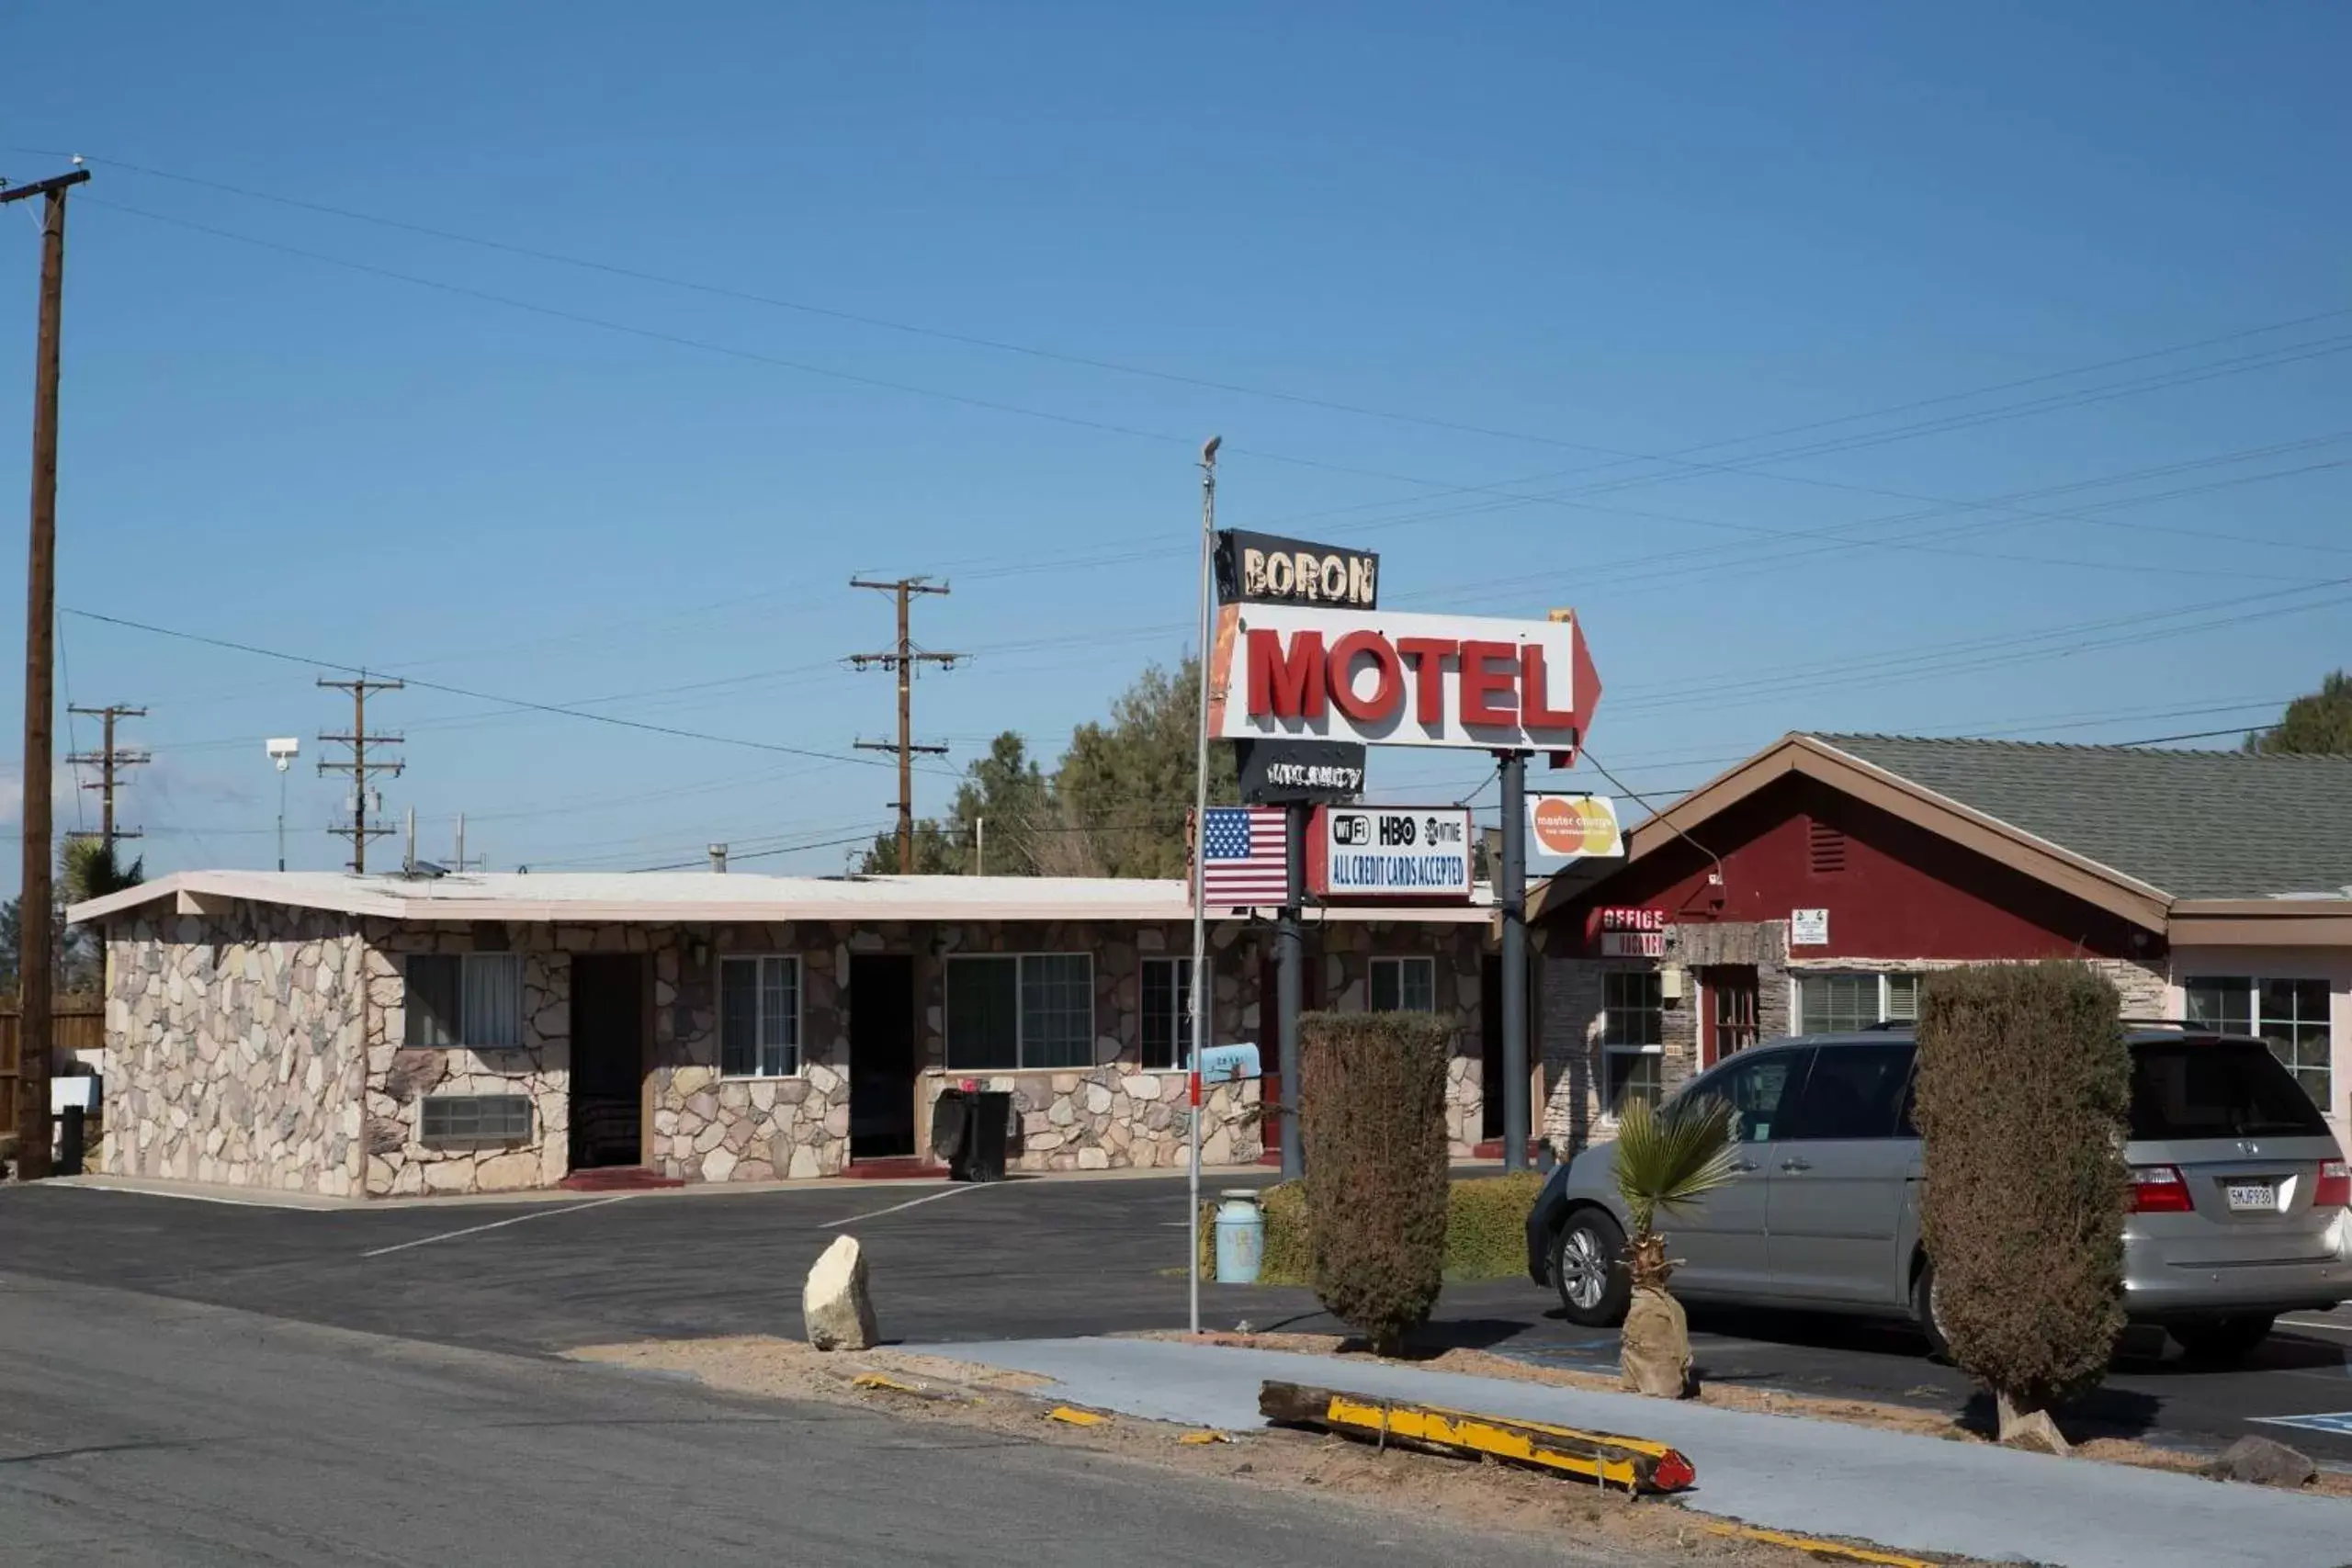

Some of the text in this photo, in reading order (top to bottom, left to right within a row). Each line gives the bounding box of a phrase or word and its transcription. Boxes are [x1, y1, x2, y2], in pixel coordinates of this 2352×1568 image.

[1244, 548, 1374, 604] BORON
[1247, 628, 1576, 728] MOTEL
[1379, 816, 1417, 846] HBO
[1333, 854, 1464, 886] ALL CREDIT CARDS ACCEPTED
[1603, 908, 1664, 930] OFFICE
